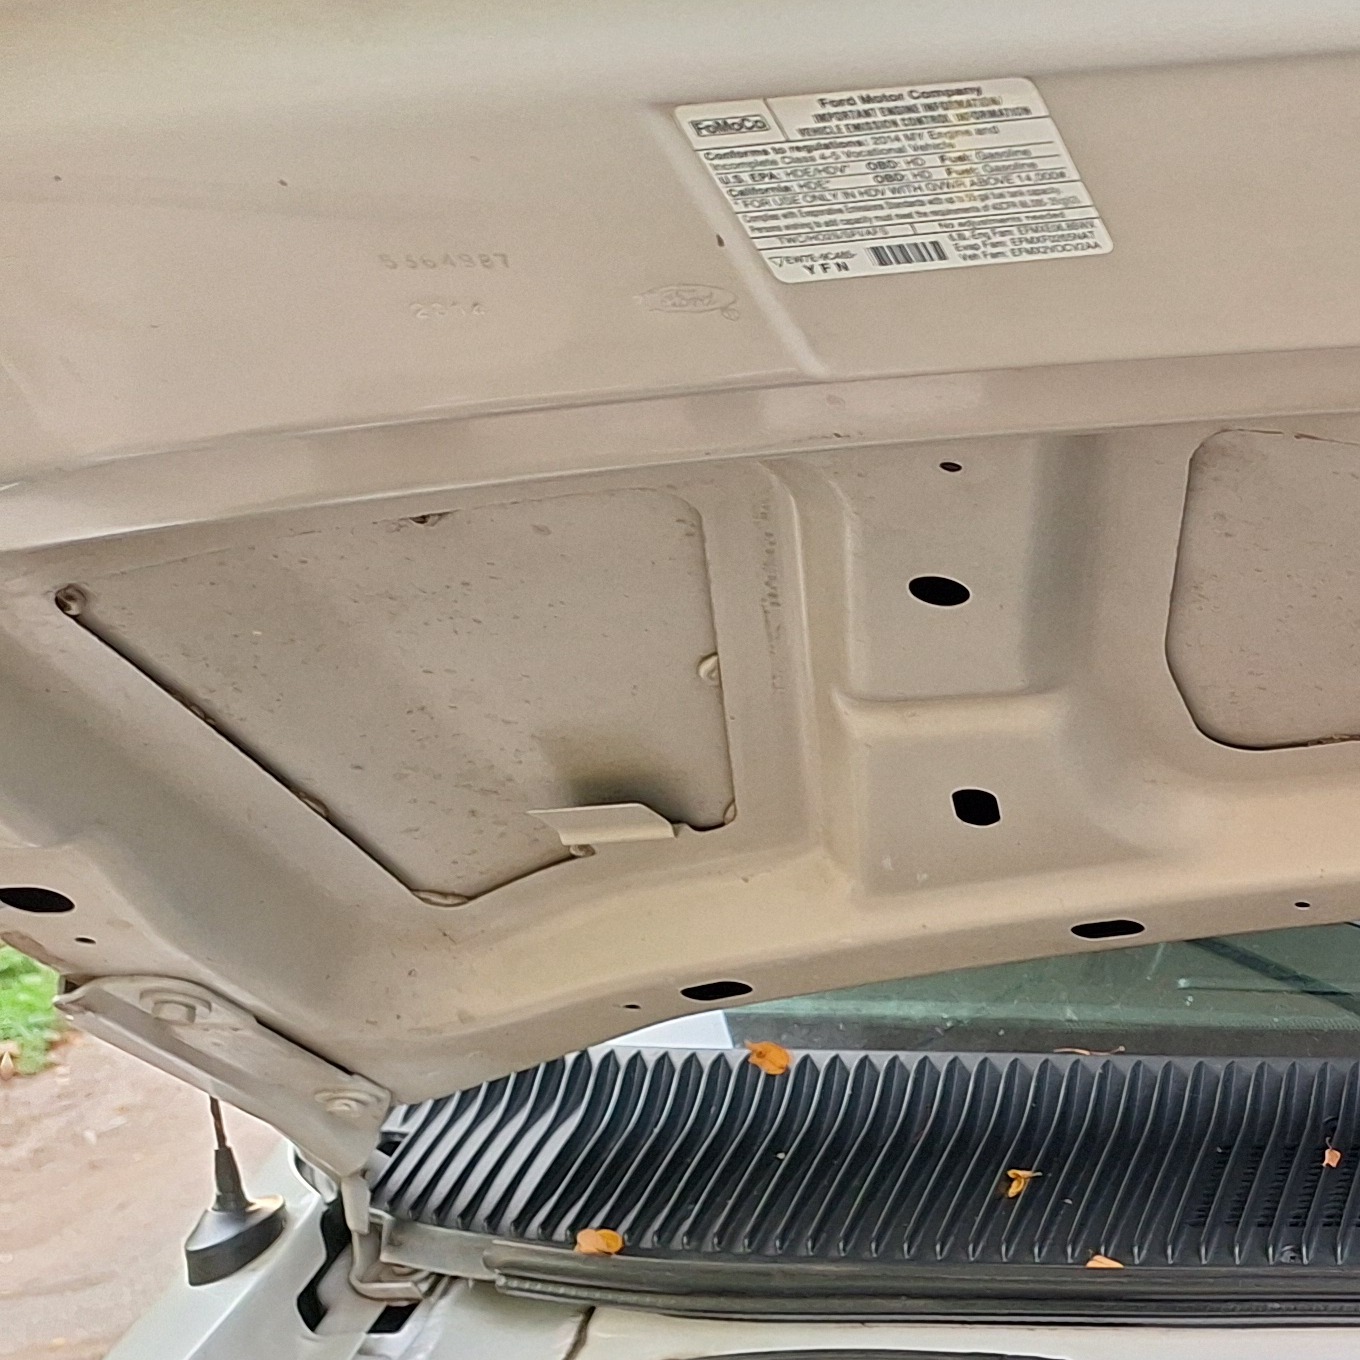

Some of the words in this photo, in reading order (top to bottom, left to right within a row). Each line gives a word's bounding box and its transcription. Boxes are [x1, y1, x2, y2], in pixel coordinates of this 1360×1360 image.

[818, 96, 858, 108] Ford
[858, 91, 905, 104] Motor
[905, 84, 984, 101] Company
[795, 124, 844, 137] VEHICLE
[842, 119, 899, 133] EMISSION
[899, 114, 950, 127] CONTROL
[949, 105, 1032, 122] INFORMATION
[810, 108, 878, 123] IMPORTANT
[878, 104, 920, 116] ENGINE
[695, 119, 766, 135] FoMoCo
[769, 145, 788, 155] to
[869, 134, 902, 145] 2014
[926, 128, 973, 141] Engine
[972, 125, 999, 135] and
[779, 153, 816, 165] Class
[974, 147, 1032, 161] Gasoline
[980, 159, 1038, 173] Gasoline
[801, 264, 818, 274] Y
[832, 261, 850, 271] N
